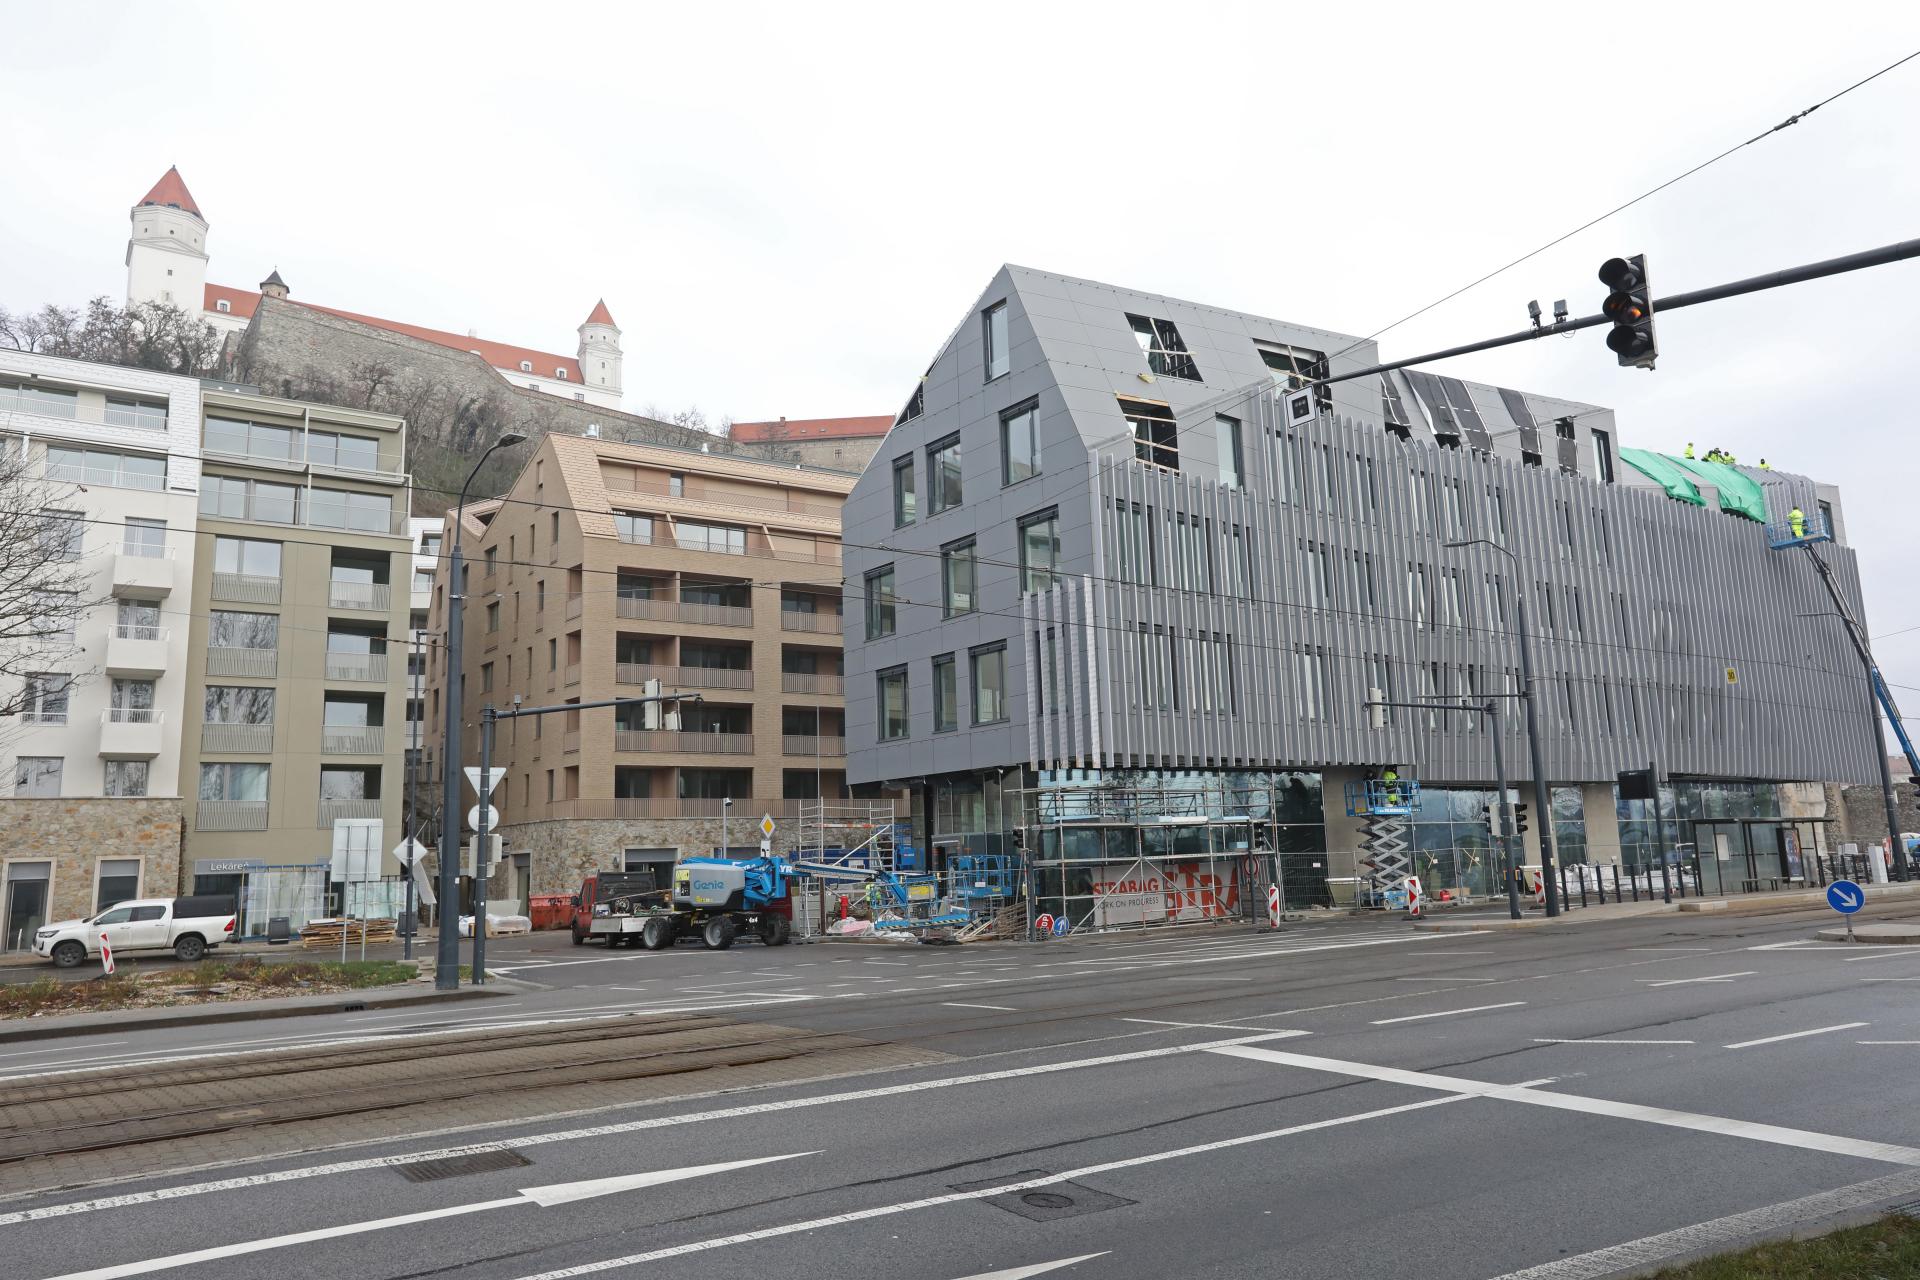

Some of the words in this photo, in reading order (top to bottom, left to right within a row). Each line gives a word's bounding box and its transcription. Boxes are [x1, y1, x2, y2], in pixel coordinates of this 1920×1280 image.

[211, 862, 248, 871] Lekáre
[694, 880, 725, 891] Genie
[1093, 877, 1159, 895] STRABAG
